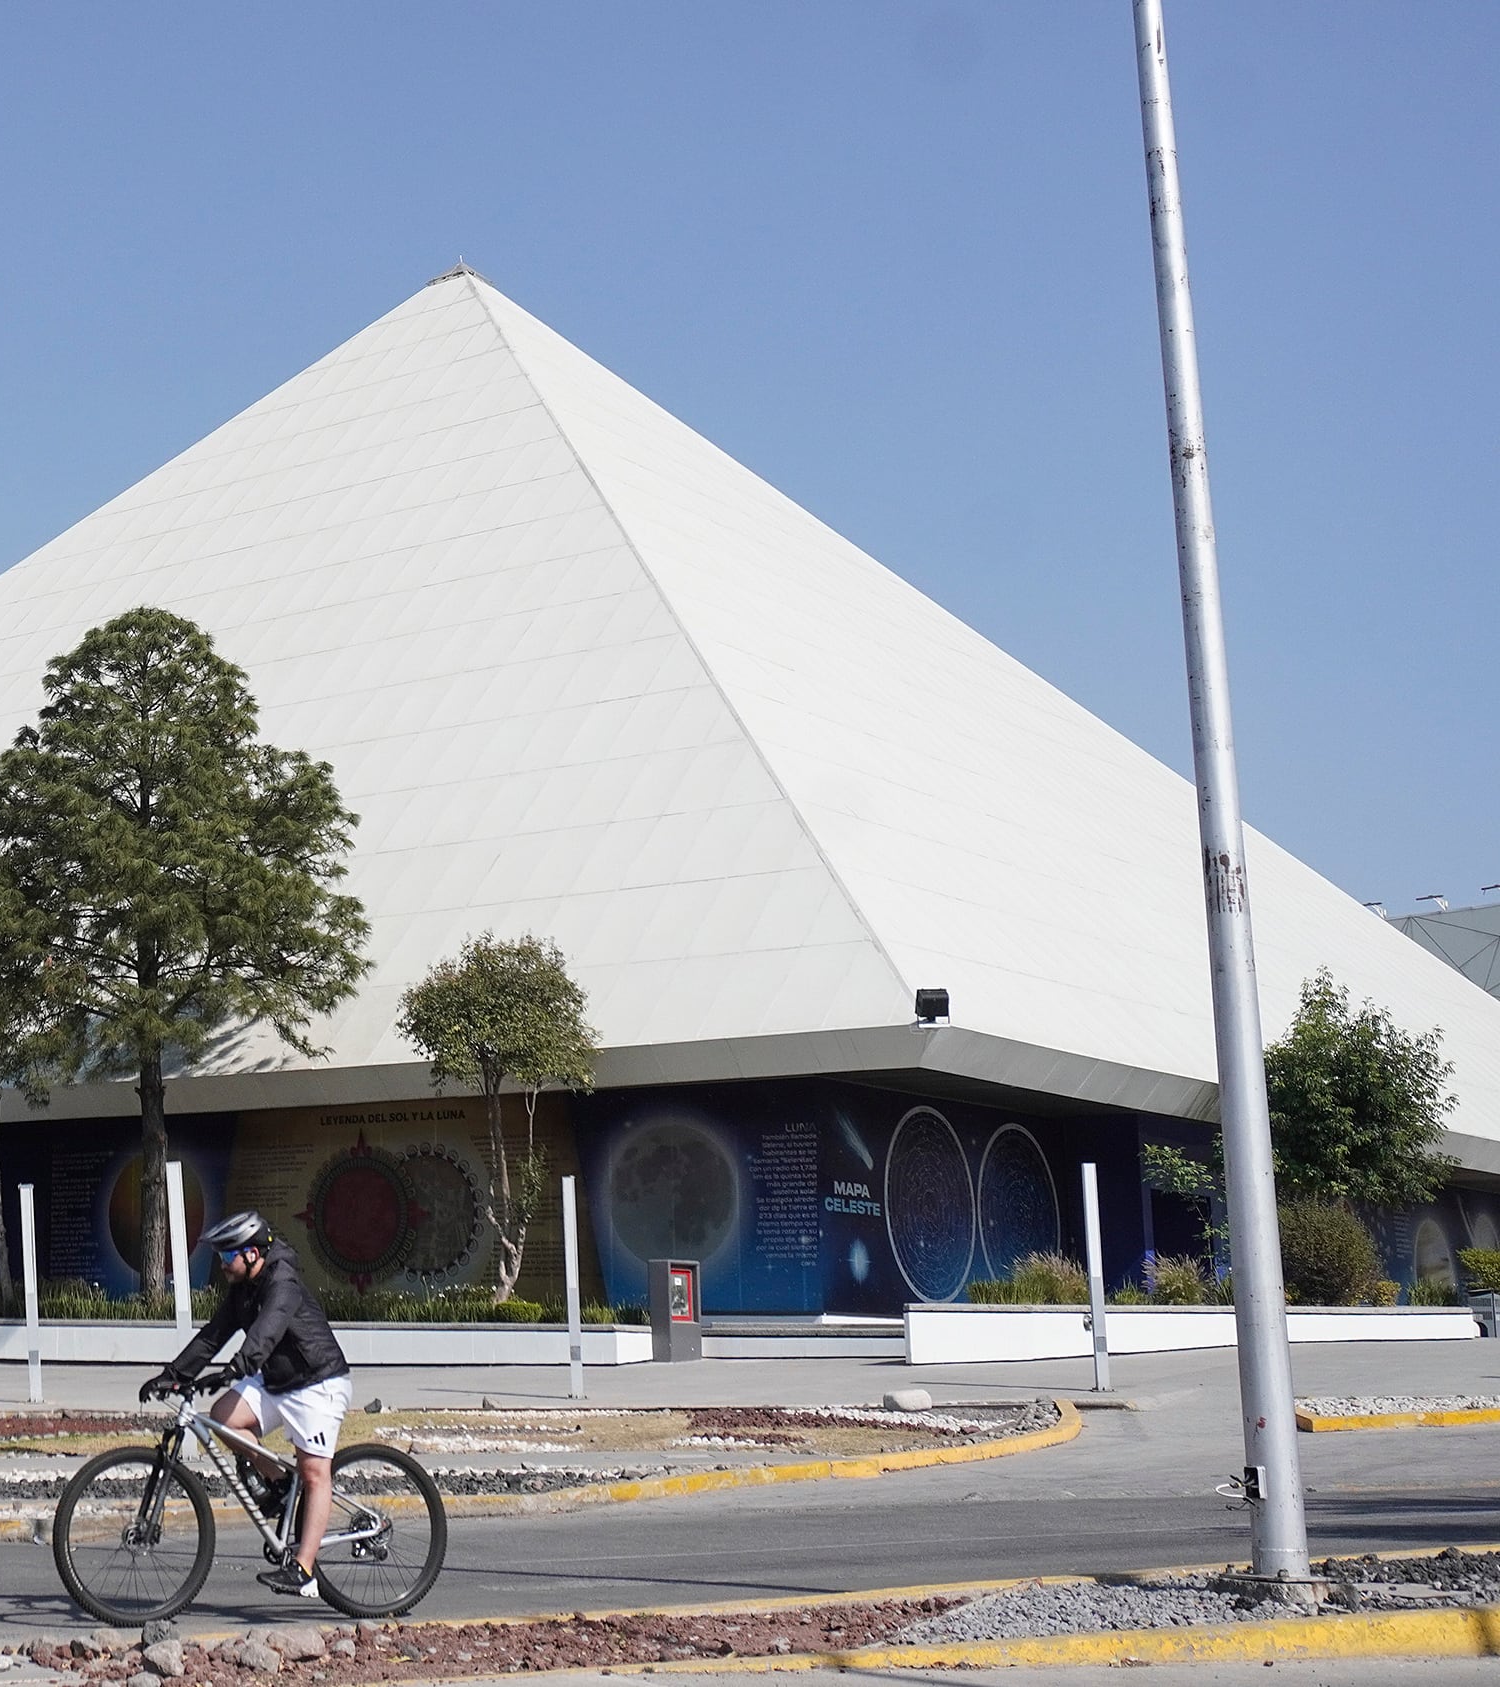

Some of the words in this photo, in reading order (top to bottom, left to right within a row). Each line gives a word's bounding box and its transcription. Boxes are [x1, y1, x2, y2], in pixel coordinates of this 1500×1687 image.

[320, 1114, 365, 1126] LEYENDA
[368, 1113, 387, 1124] DEL
[389, 1112, 409, 1123] SOL
[411, 1111, 418, 1121] Y
[420, 1111, 434, 1121] LA
[437, 1109, 466, 1120] LUNA
[785, 1122, 817, 1133] LUNA
[782, 1181, 806, 1189] grande
[833, 1180, 871, 1199] MAPA
[824, 1196, 881, 1217] CELESTE
